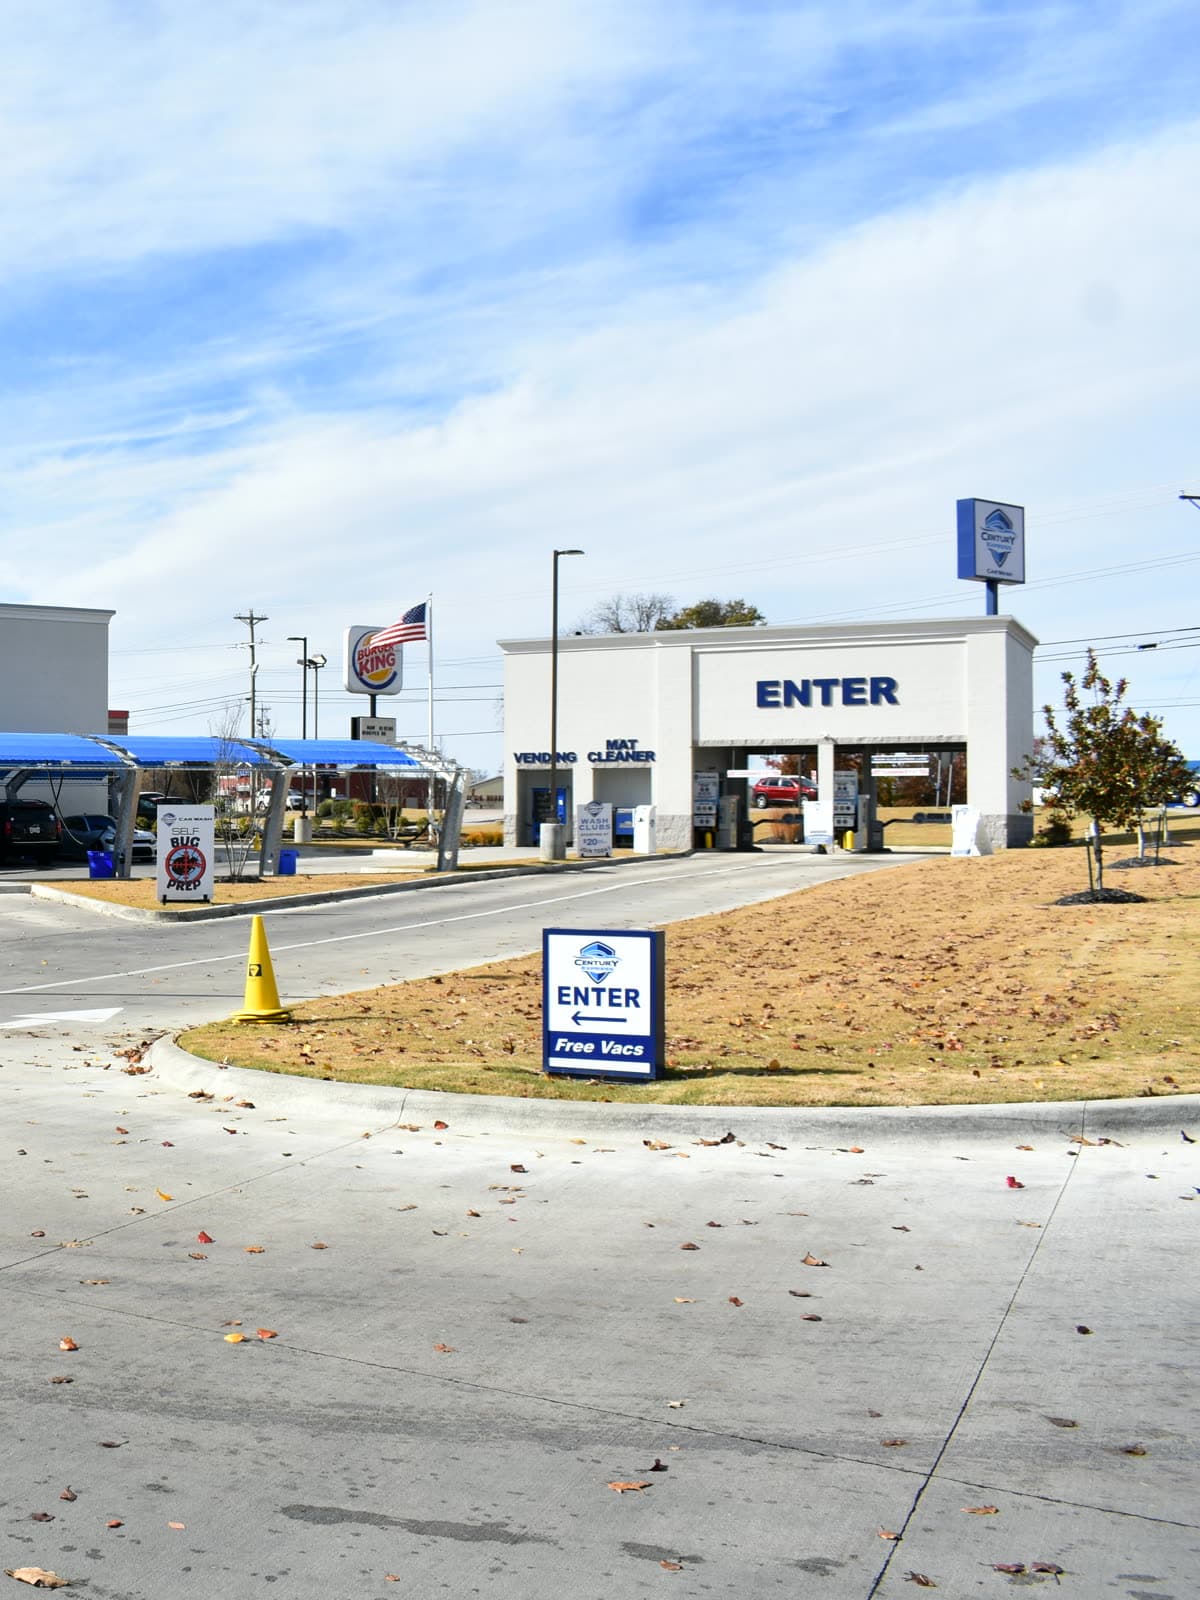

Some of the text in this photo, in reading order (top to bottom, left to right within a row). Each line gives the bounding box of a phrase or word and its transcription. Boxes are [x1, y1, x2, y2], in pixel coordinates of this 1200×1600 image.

[358, 652, 396, 676] KING
[756, 676, 900, 708] ENTER
[606, 739, 638, 750] MAT
[514, 752, 577, 763] VENDNG
[587, 750, 656, 762] CLEANER
[171, 827, 200, 836] SELF
[170, 836, 200, 848] BUG
[166, 879, 202, 891] PREP
[574, 959, 619, 967] CENTURY
[557, 986, 641, 1008] ENTER
[555, 1038, 644, 1056] Free Vacs
